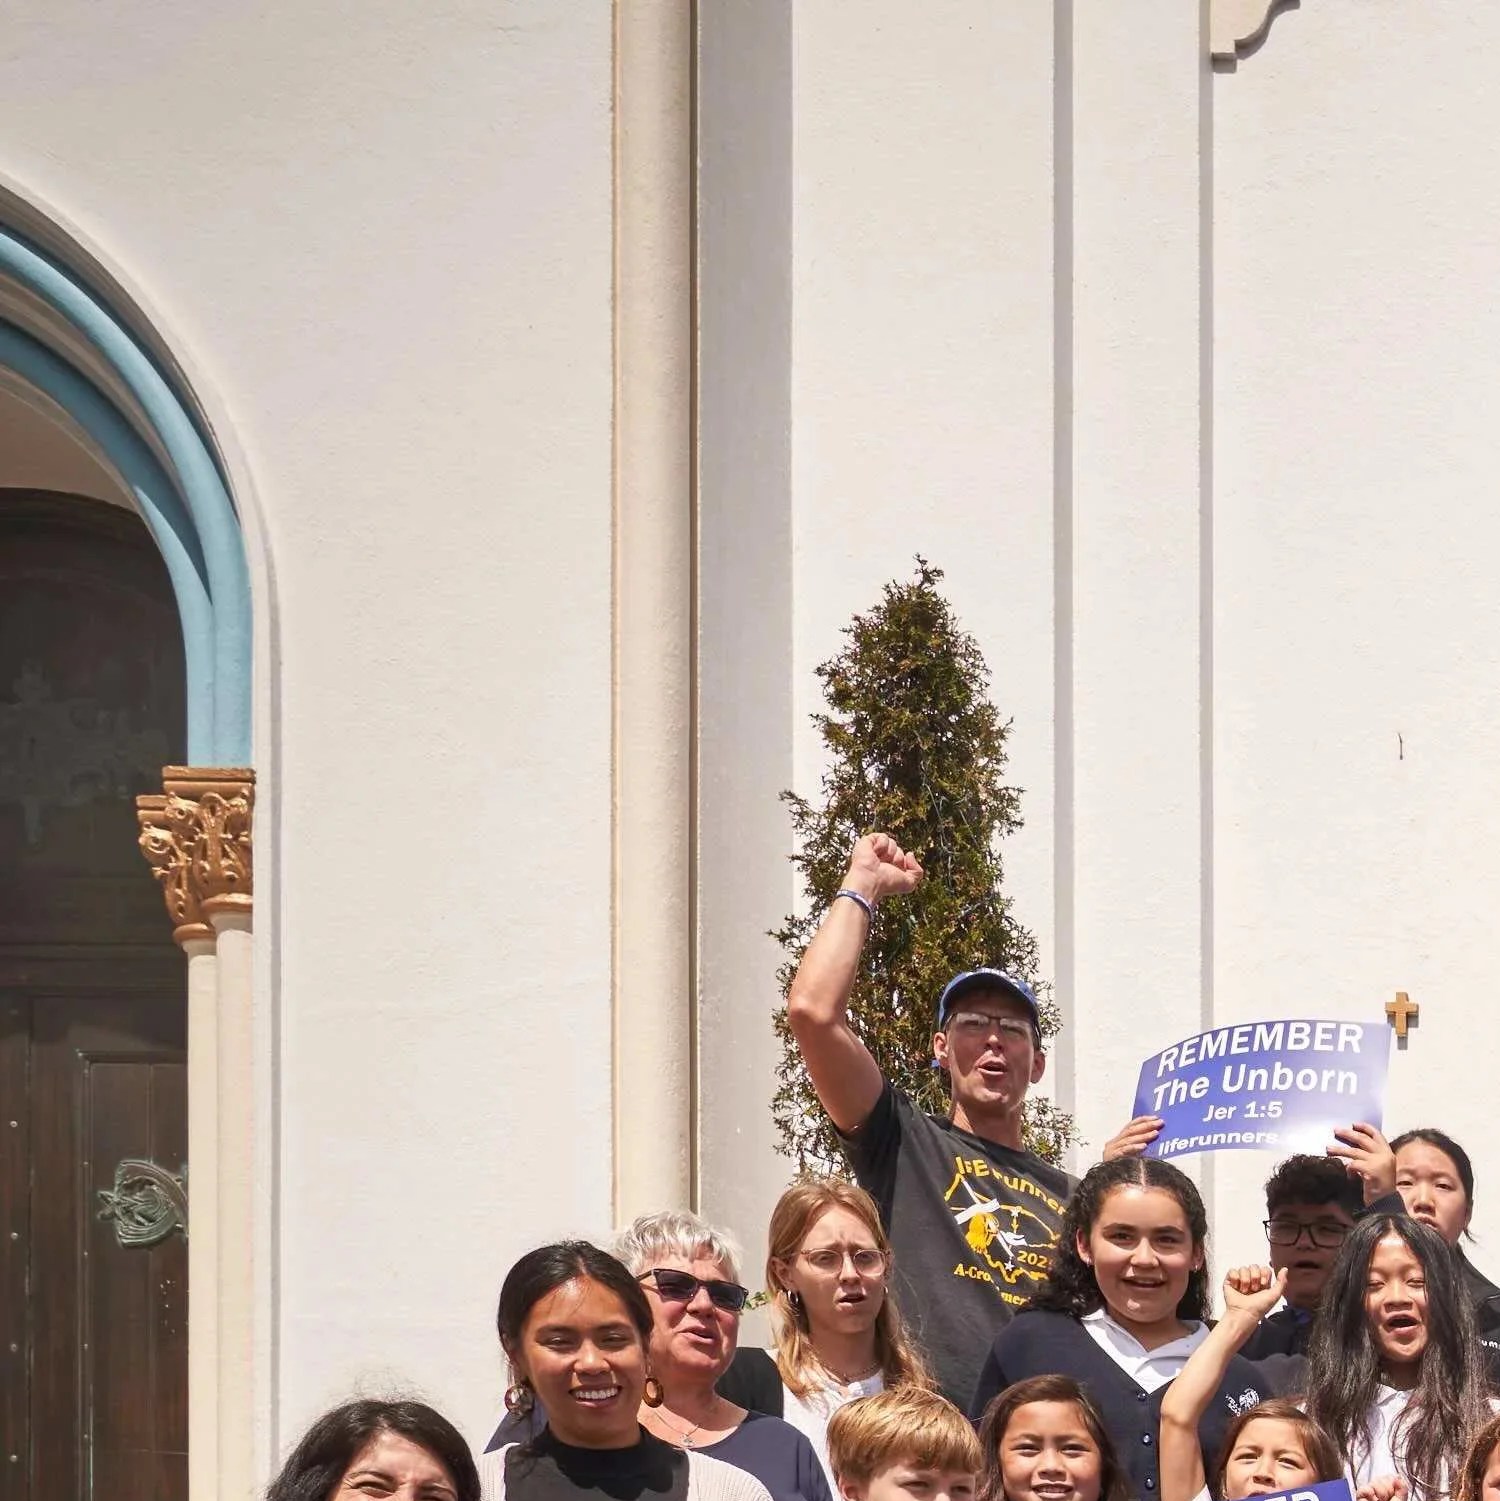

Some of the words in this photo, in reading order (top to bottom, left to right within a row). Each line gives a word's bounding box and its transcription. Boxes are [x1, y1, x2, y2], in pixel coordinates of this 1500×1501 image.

[1157, 1021, 1364, 1078] REMEMBER
[1153, 1074, 1210, 1112] The
[1222, 1061, 1358, 1095] Unborn
[1203, 1104, 1236, 1122] Jer
[1244, 1101, 1283, 1118] 1:5
